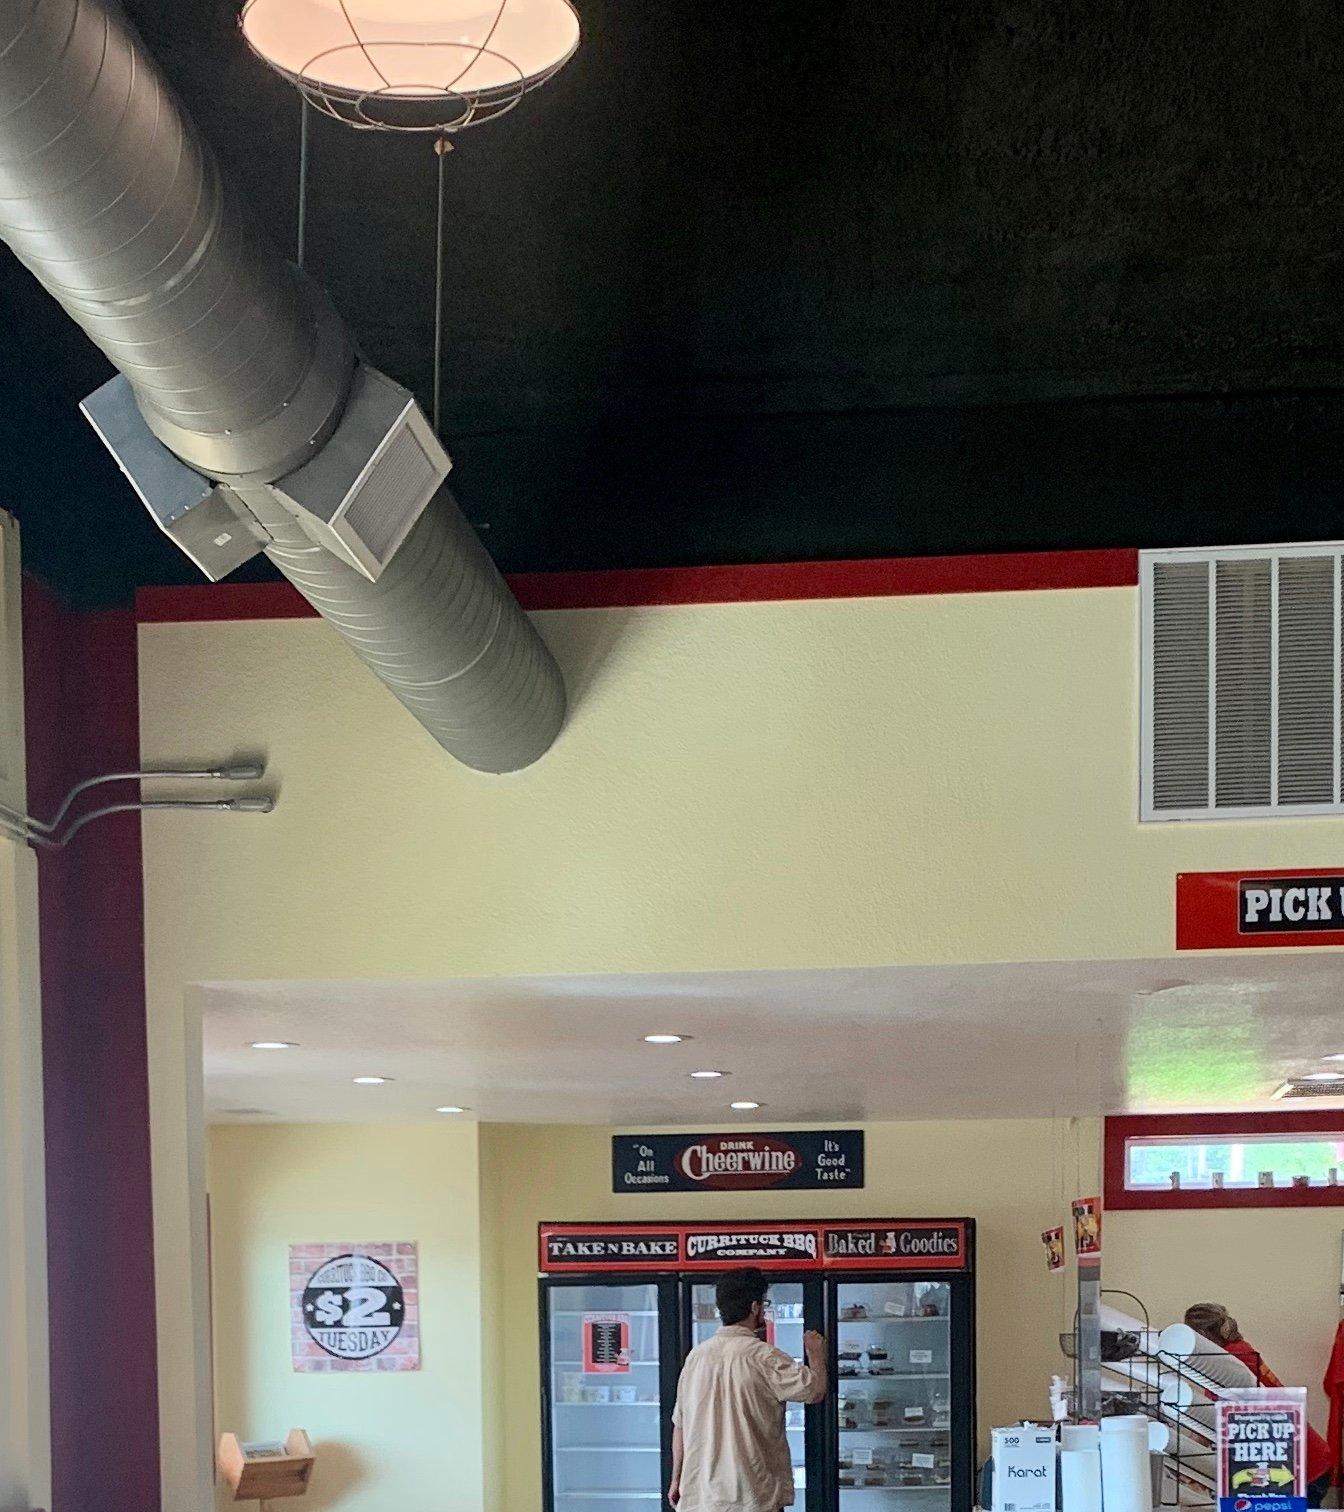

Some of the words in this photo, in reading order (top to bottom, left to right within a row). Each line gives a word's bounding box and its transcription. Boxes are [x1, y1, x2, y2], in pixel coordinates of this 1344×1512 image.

[1245, 887, 1332, 923] PICK
[720, 1141, 754, 1151] DRINK
[824, 1140, 840, 1152] It's
[637, 1160, 655, 1172] All
[681, 1145, 796, 1181] Cheerwine
[817, 1154, 846, 1166] Good
[624, 1173, 669, 1184] Occasions
[549, 1241, 605, 1256] TAKE
[607, 1243, 619, 1254] N
[621, 1241, 677, 1255] BAKE
[687, 1233, 780, 1257] CURRITUCK
[782, 1233, 817, 1260] BBQ
[828, 1232, 876, 1254] Baked
[900, 1231, 957, 1253] Goodies
[716, 1248, 787, 1256] COMPANY
[316, 1288, 391, 1327] $2
[318, 1331, 390, 1352] TUESDAY
[1228, 1423, 1270, 1440] PICK
[1272, 1423, 1296, 1439] UP
[1234, 1442, 1288, 1462] HERE
[1007, 1465, 1047, 1477] Karat
[1254, 1501, 1292, 1512] pepsi
